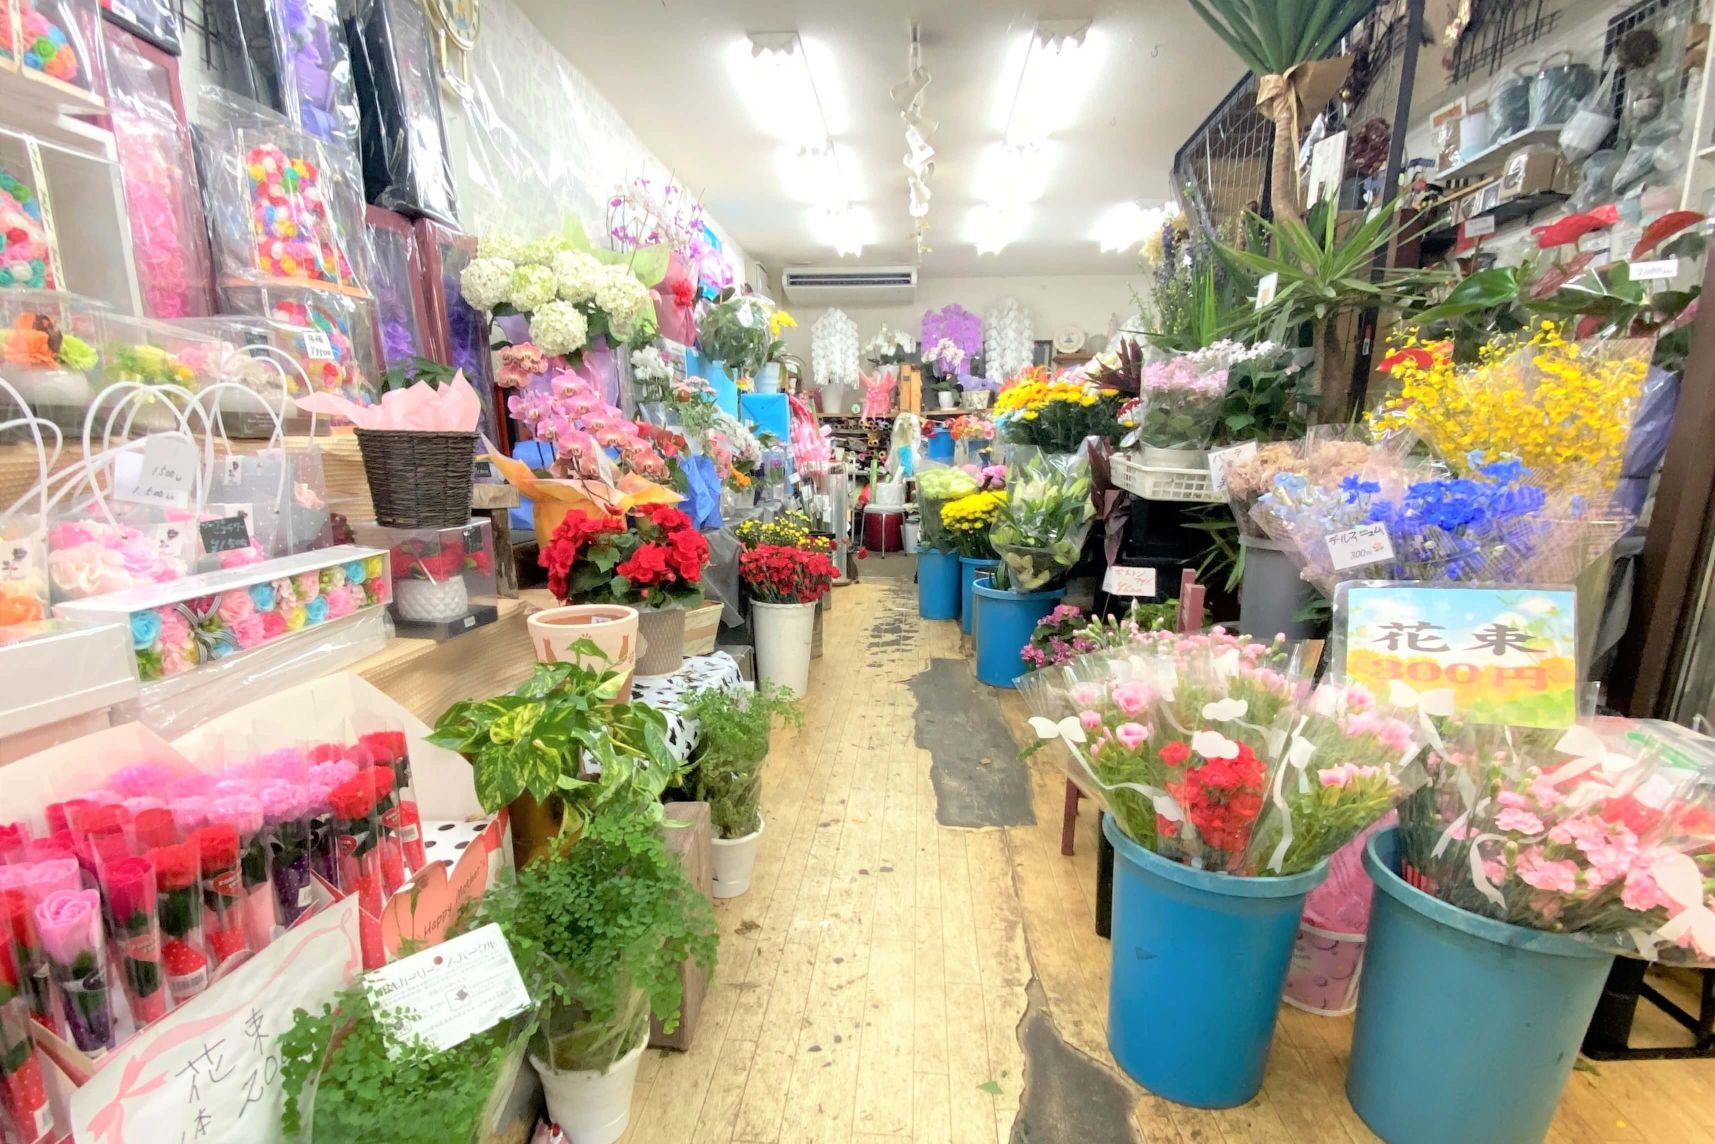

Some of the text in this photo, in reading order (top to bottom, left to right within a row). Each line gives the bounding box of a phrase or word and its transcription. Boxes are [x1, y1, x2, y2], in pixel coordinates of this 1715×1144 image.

[1371, 621, 1547, 656] 花束
[1371, 659, 1548, 690] 300円
[424, 903, 452, 937] Happy
